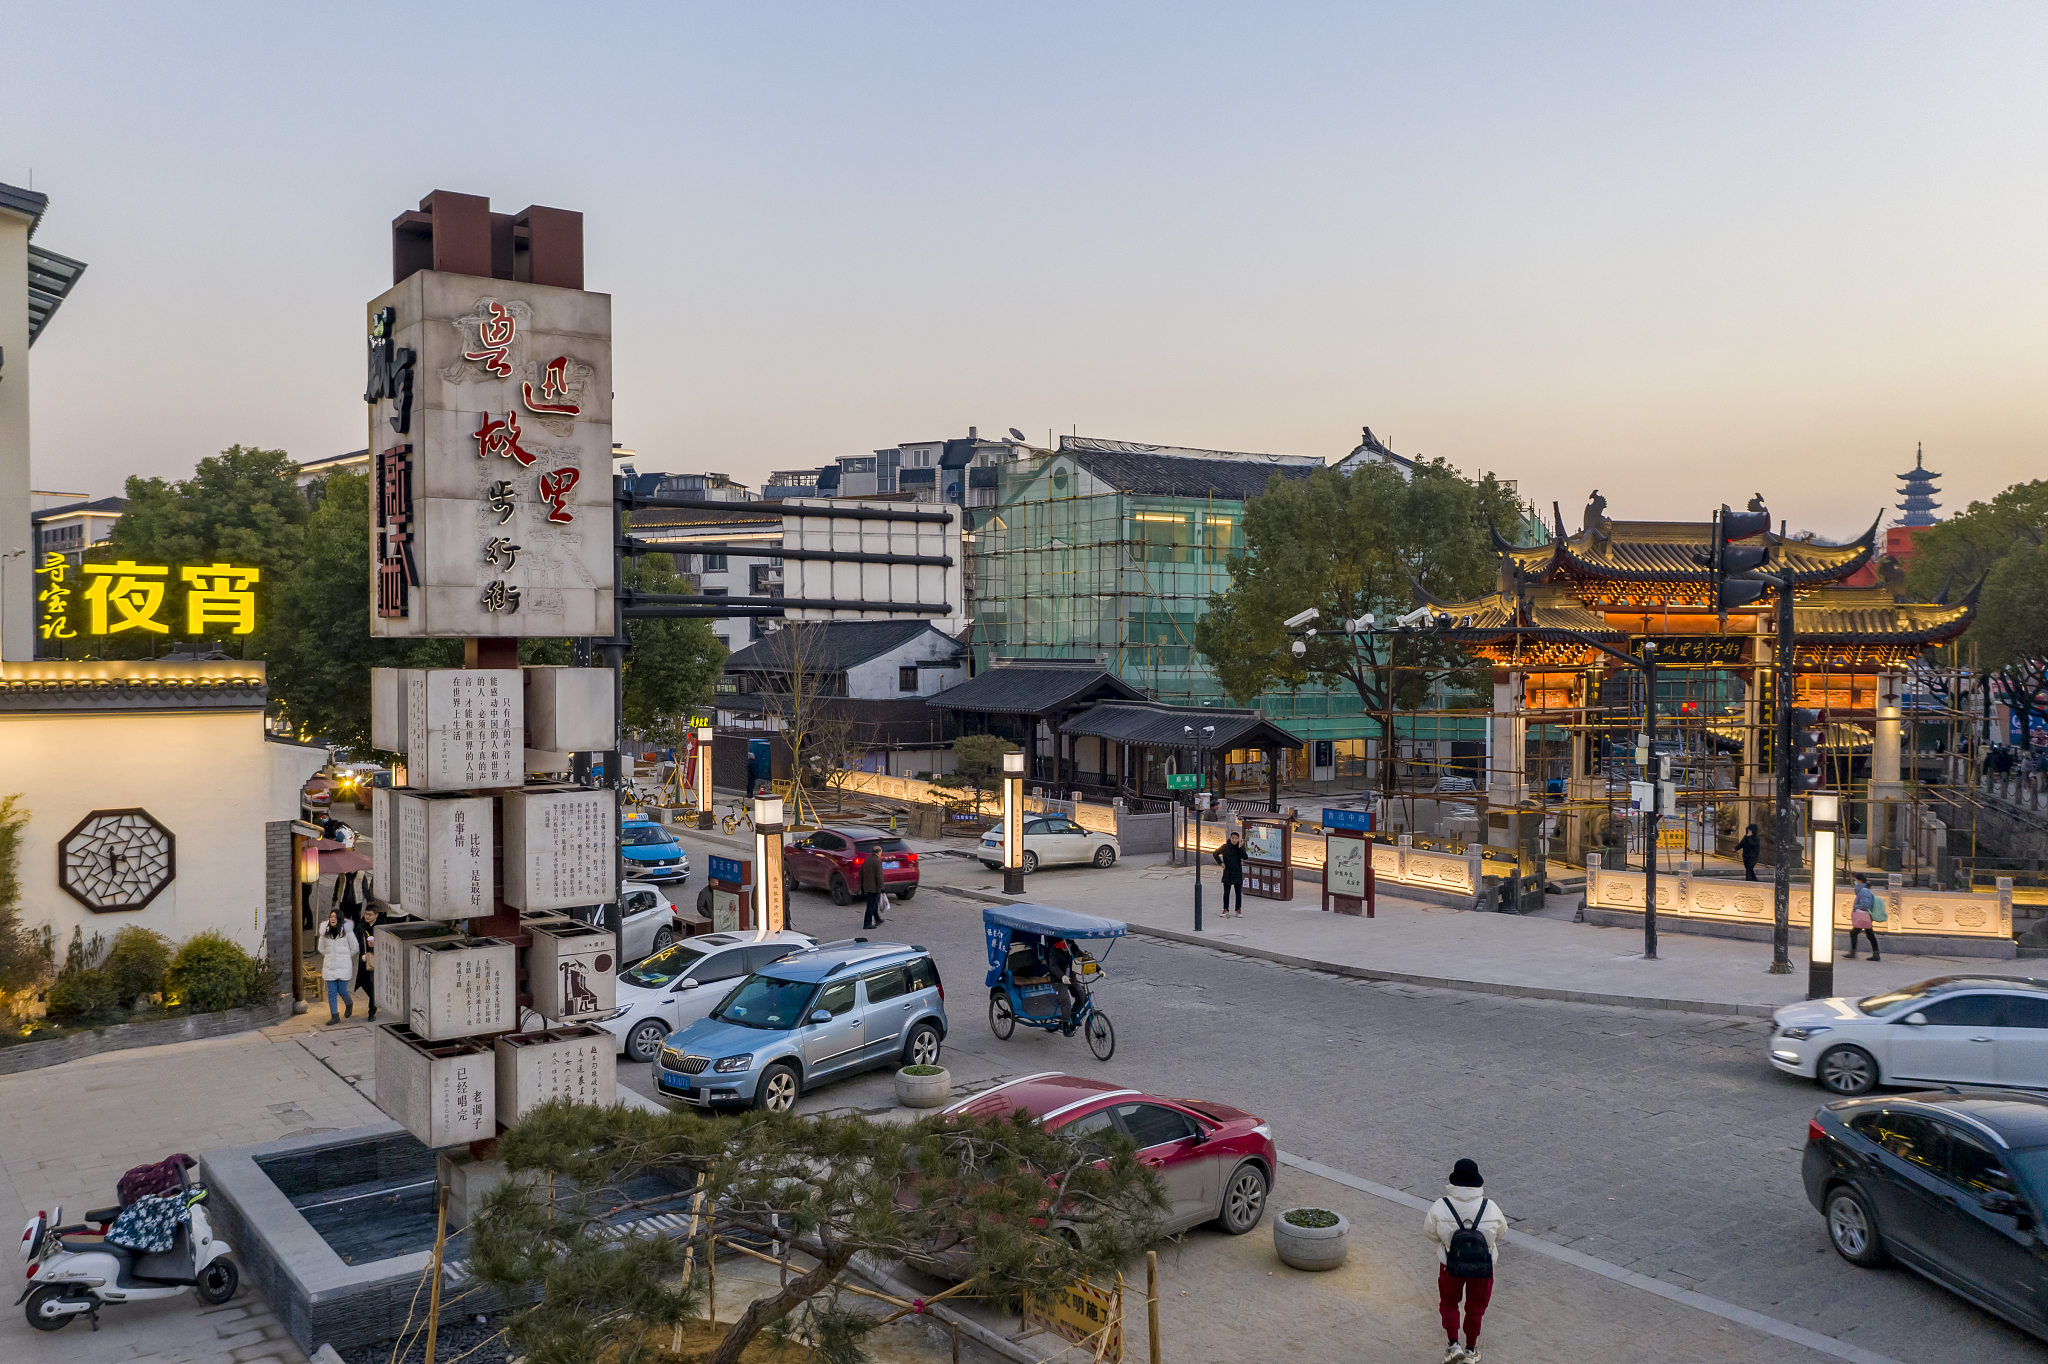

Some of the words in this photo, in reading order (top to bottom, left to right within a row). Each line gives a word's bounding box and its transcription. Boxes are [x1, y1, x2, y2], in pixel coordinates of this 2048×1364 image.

[483, 480, 522, 615] 步行街
[83, 560, 260, 635] 夜宵
[490, 677, 499, 781] 能感动中国的人和世界
[1328, 811, 1365, 822] 鲁迅中路
[470, 833, 481, 906] 比较，是最好
[713, 859, 738, 873] 鲁迅中路
[457, 1067, 467, 1122] 已经唱完
[472, 1090, 482, 1130] 老调子
